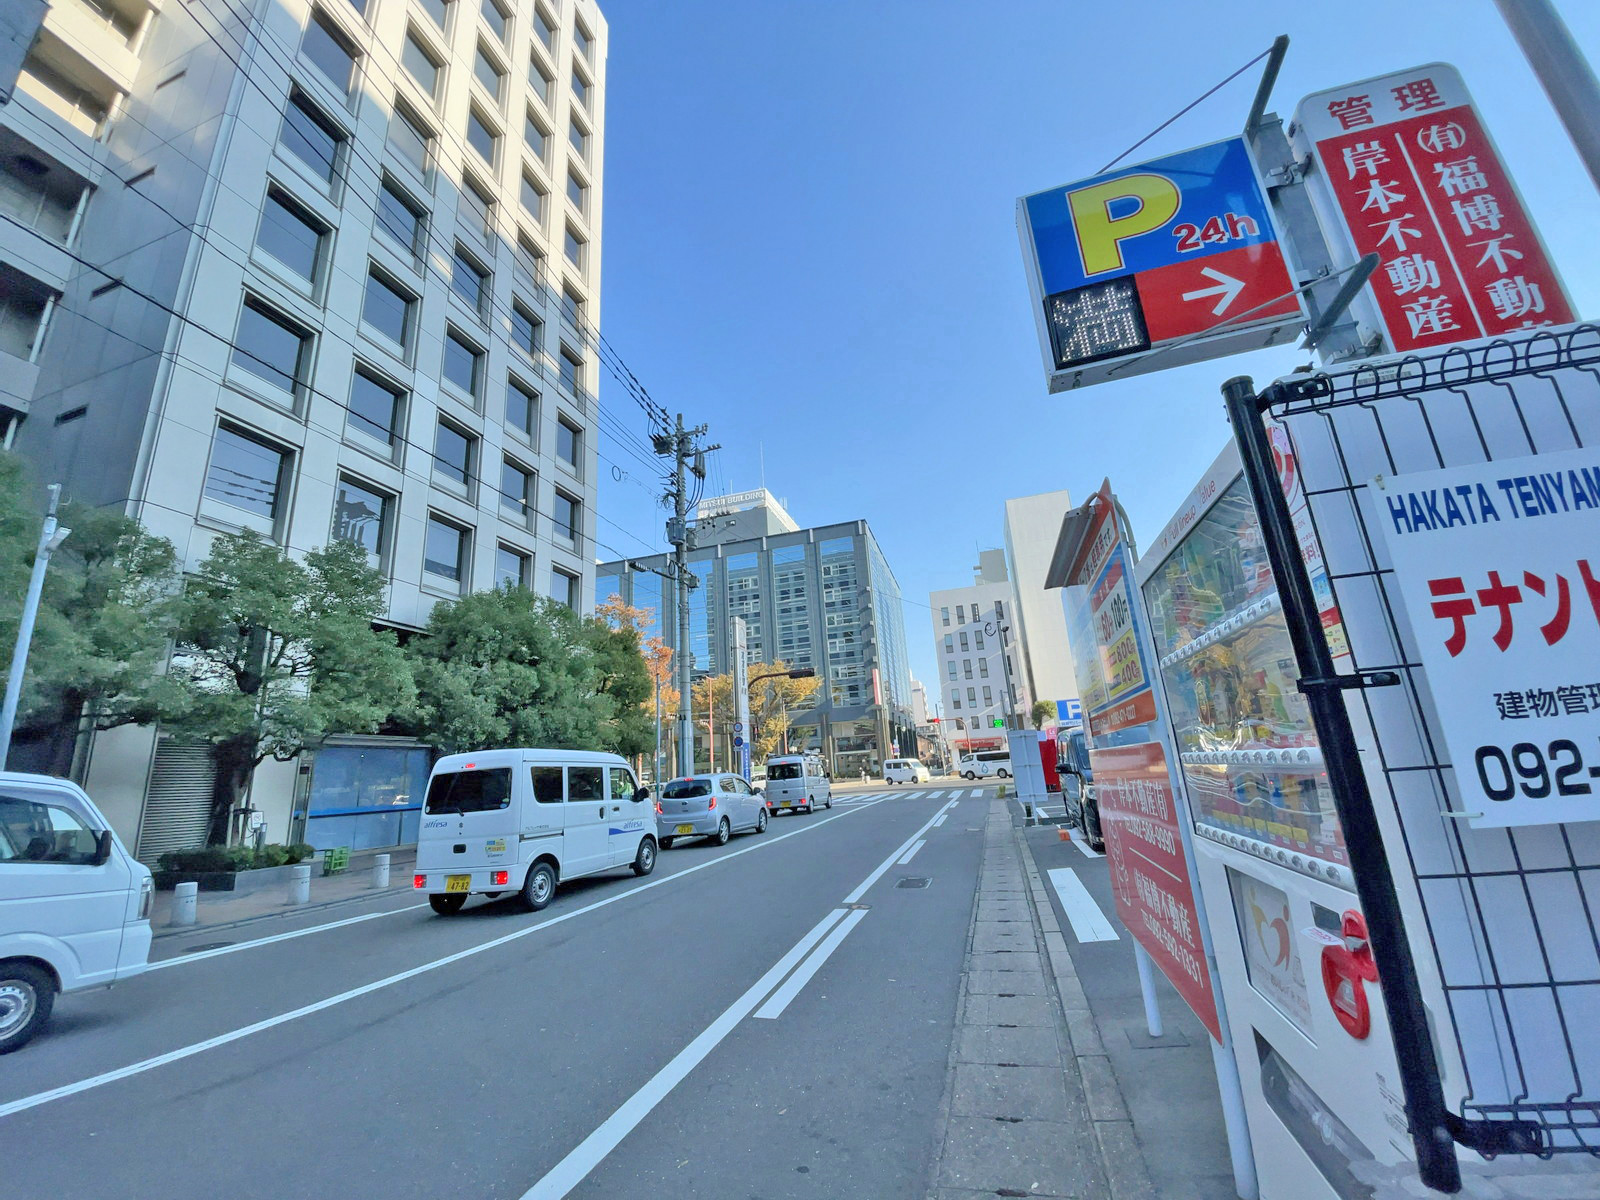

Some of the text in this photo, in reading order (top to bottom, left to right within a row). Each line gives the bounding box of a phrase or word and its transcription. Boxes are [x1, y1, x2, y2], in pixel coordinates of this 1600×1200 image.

[1065, 173, 1182, 278] P
[1172, 212, 1260, 253] 24h
[1341, 140, 1462, 340] 岸本不動産
[1416, 121, 1554, 333] (有)福博不動
[1053, 285, 1142, 363] 満
[727, 490, 765, 504] BUILDING
[1386, 466, 1600, 535] HAKATA TENYA
[423, 819, 448, 829] alfresa
[622, 818, 643, 830] alfresa
